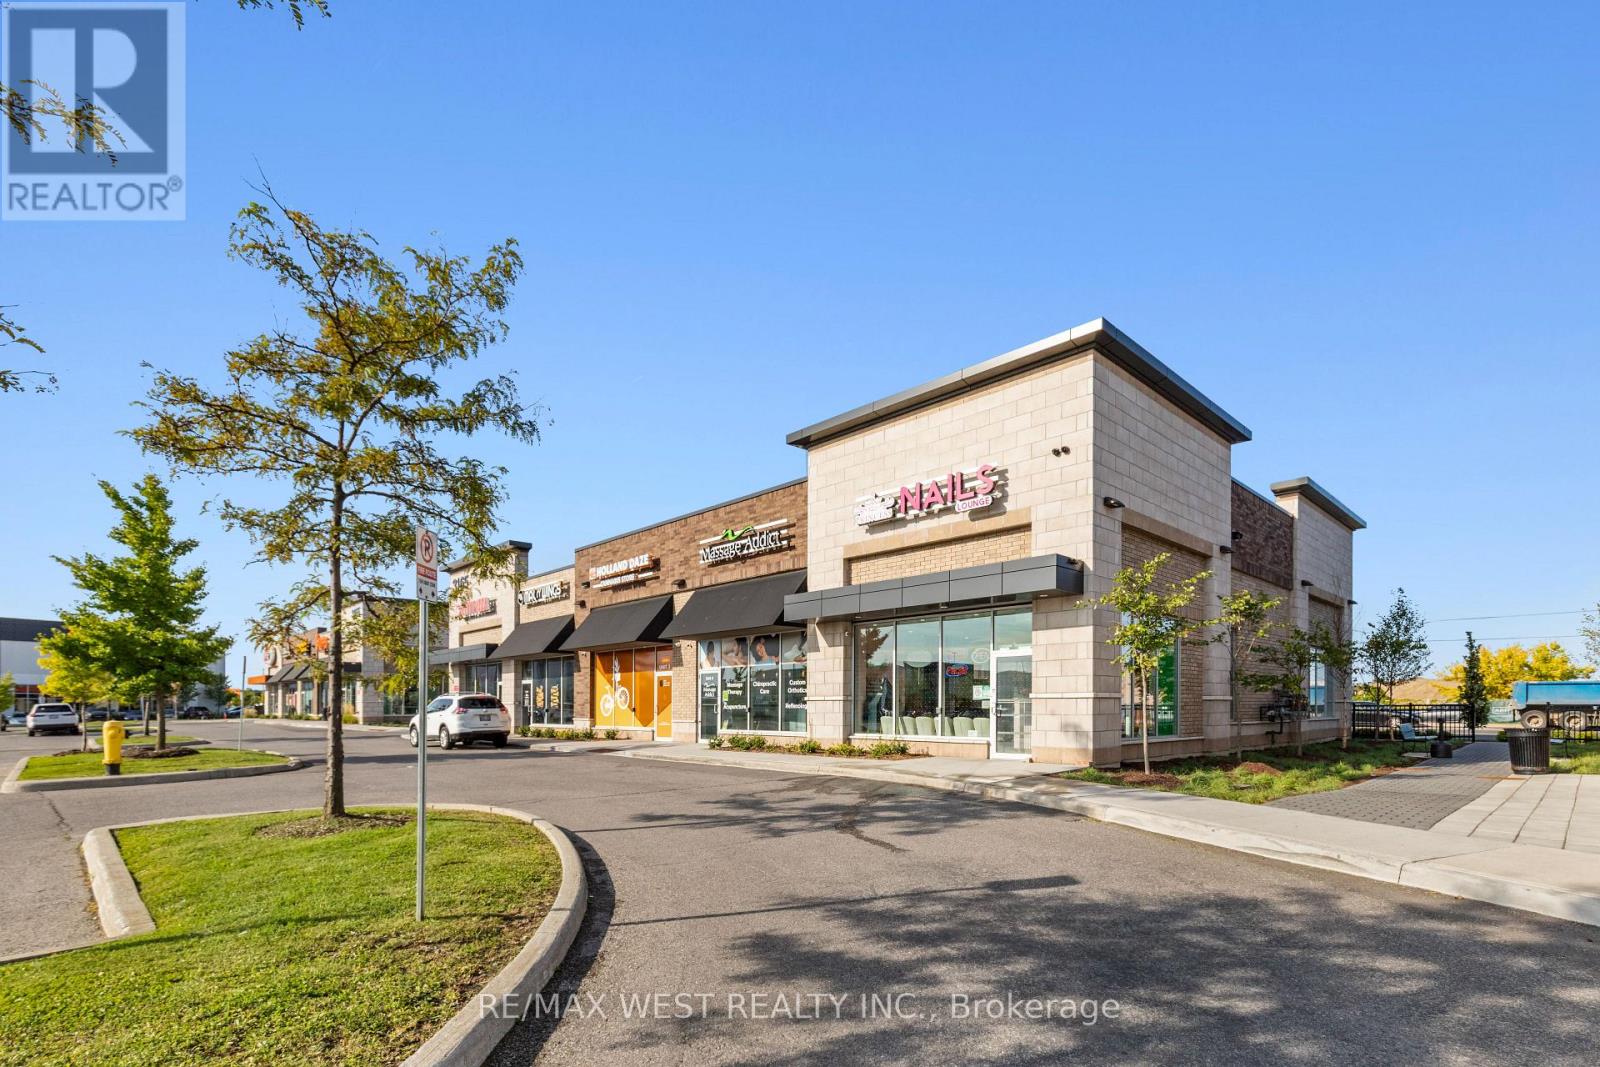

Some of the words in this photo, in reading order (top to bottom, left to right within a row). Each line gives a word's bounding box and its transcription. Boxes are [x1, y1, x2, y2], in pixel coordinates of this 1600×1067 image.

[899, 464, 996, 513] NAILS
[956, 496, 991, 511] LOUNGE
[699, 541, 741, 562] Massage
[743, 529, 781, 553] Addict
[597, 559, 628, 578] HOLLAND
[628, 553, 649, 570] DAZE
[541, 584, 561, 600] WINGS
